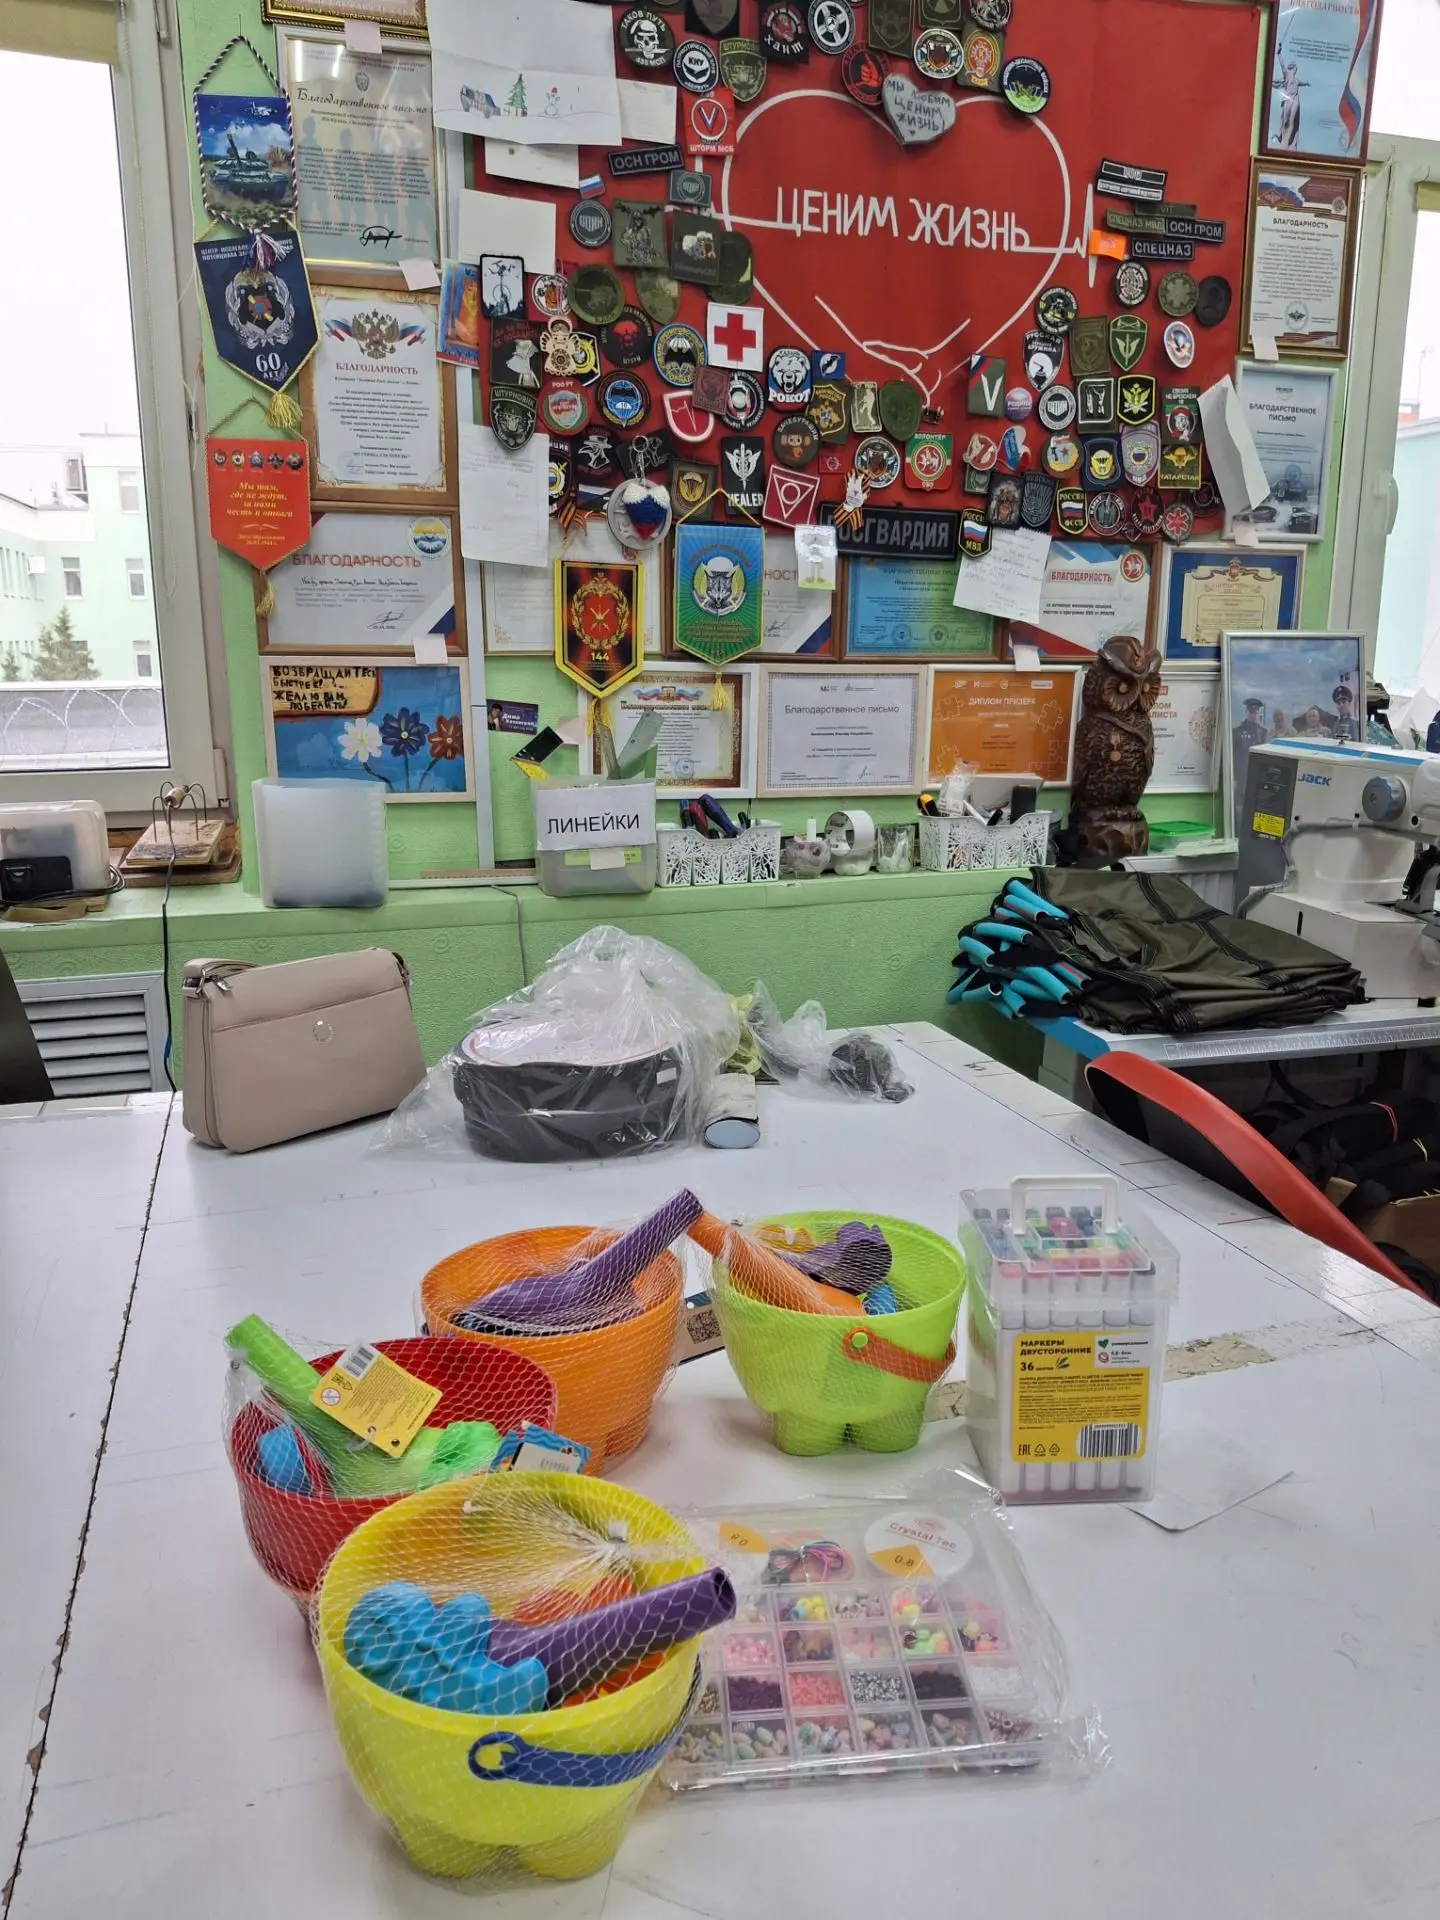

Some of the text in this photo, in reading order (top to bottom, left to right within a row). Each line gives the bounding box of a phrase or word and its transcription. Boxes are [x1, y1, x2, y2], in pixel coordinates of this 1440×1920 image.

[886, 79, 905, 92] МЫ
[894, 96, 943, 119] ЦЕНИМ
[614, 150, 680, 169] ОСН ГРОМ
[776, 186, 1031, 252] ЦЕНИМ ЖИЗНЬ
[1169, 221, 1222, 238] ОСН ГРОМ
[1134, 241, 1192, 257] СПЕЦНАЗ
[255, 352, 281, 373] 60
[336, 362, 420, 376] БЛАГОДАРНОСТЬ
[768, 391, 811, 403] РОКОТ
[1249, 403, 1317, 416] БЛАГОДАРСТВЕННОЕ
[1268, 413, 1297, 423] ПИСЬМО
[1160, 474, 1200, 482] ТАТАРСТАН
[727, 493, 765, 507] HEALER
[292, 552, 422, 569] БЛАГОДАРНОСТЬ
[1051, 571, 1112, 583] БЛАГОДАРНОСТЬ
[590, 652, 610, 662] 144
[968, 697, 1002, 707] ДИПЛОМ
[784, 704, 900, 716] Благодарственное письмо
[546, 812, 641, 835] ЛИНЕЙКИ
[1020, 1339, 1065, 1348] МАРКЕРЫ
[1020, 1347, 1093, 1357] ДВУСТОРОННИЕ
[1020, 1361, 1035, 1372] 36
[889, 1521, 934, 1541] Crystal
[894, 1554, 915, 1567] 0.8
